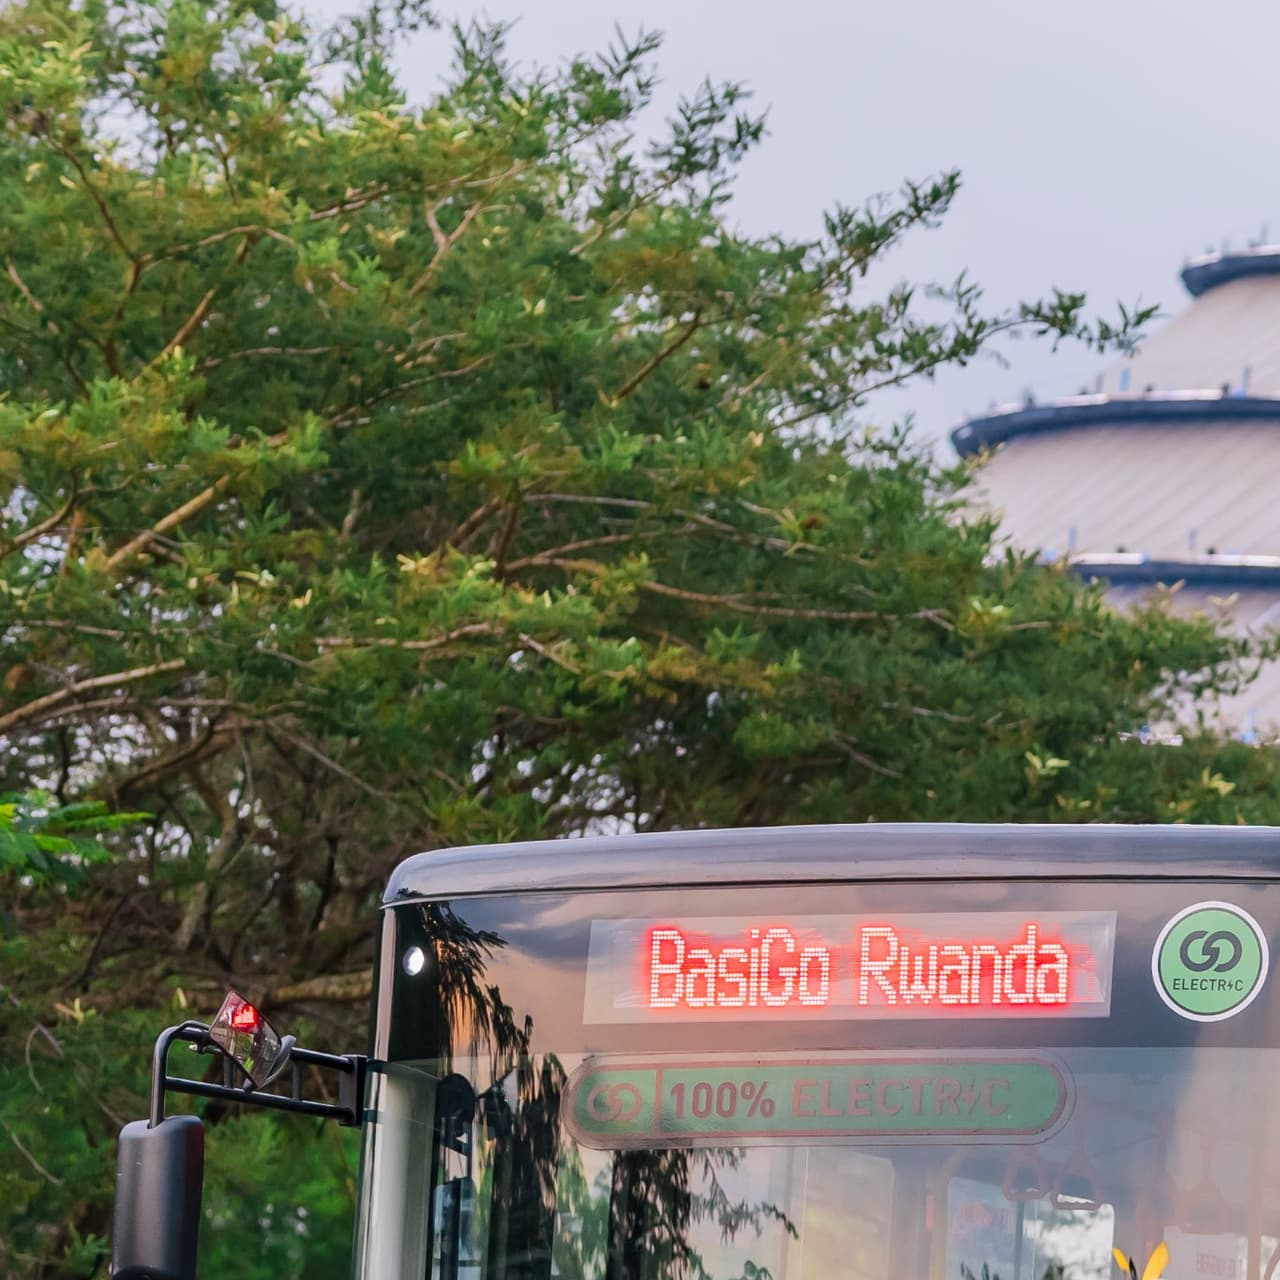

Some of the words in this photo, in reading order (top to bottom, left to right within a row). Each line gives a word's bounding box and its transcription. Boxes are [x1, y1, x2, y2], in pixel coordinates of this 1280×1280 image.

[650, 928, 830, 1007] BasiGo
[858, 924, 1069, 1005] Rwanda
[670, 1080, 775, 1119] 100%
